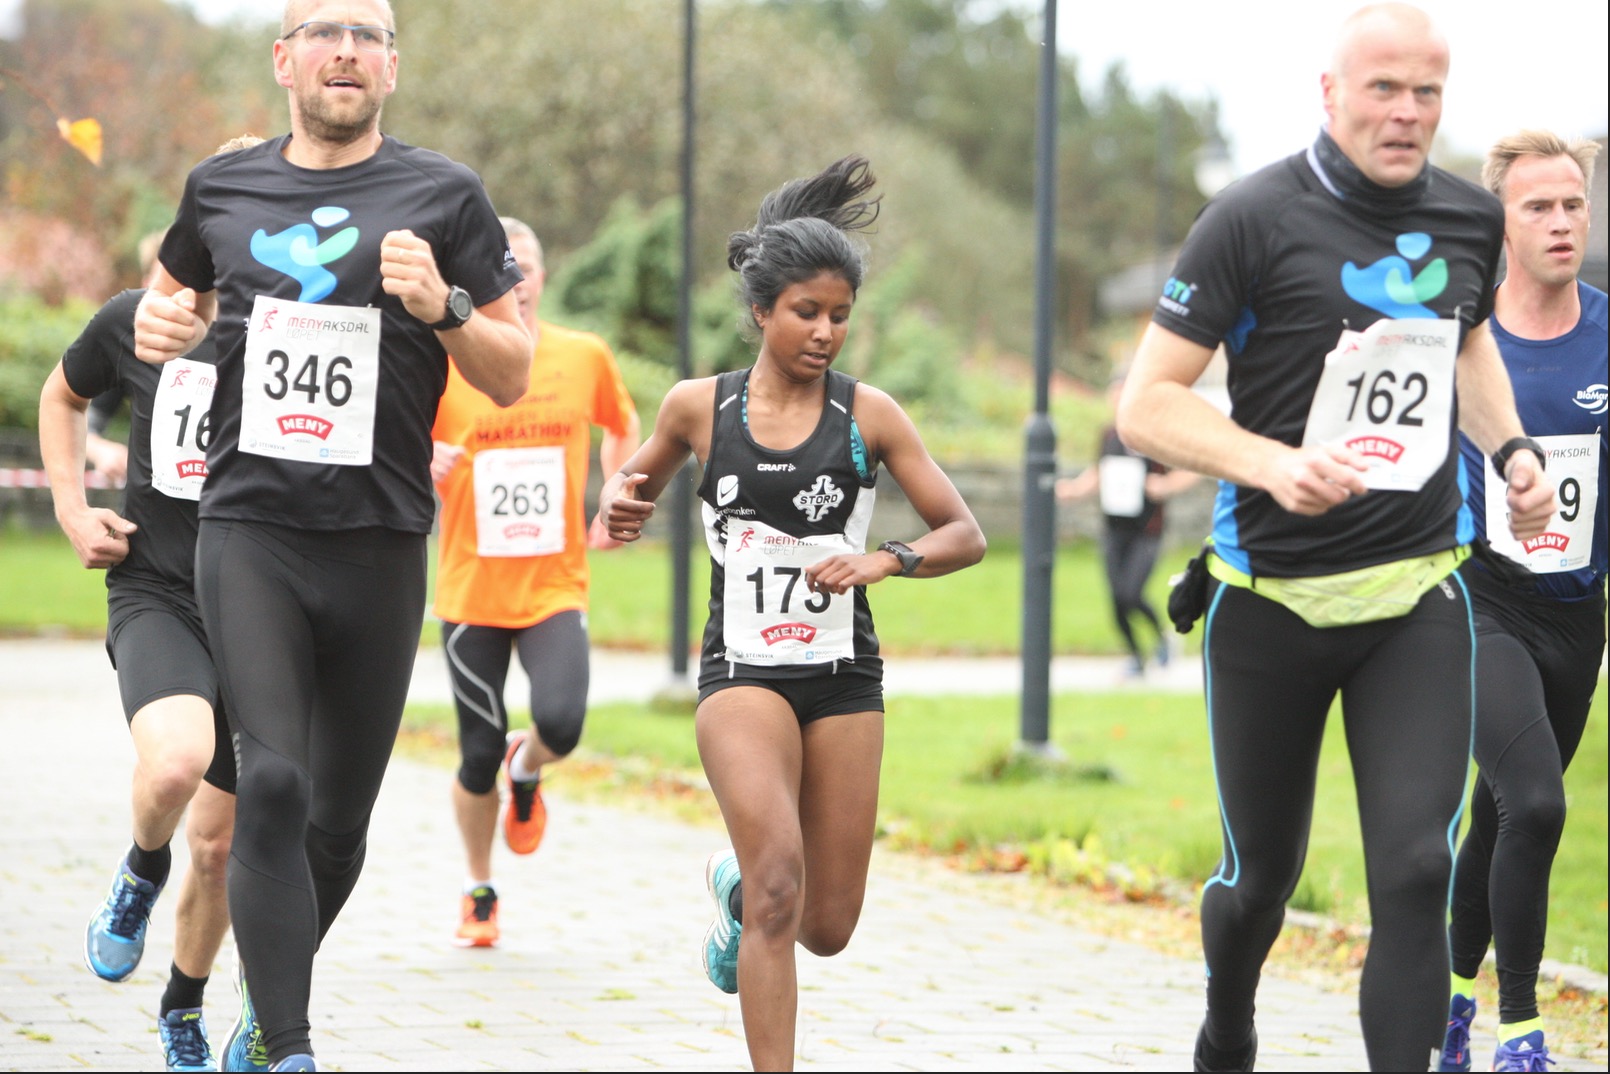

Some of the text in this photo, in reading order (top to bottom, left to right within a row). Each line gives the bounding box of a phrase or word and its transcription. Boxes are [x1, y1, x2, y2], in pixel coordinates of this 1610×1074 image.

[263, 349, 353, 407] 346
[1346, 369, 1428, 427] 162
[281, 418, 328, 434] MENY
[1350, 439, 1400, 457] MENY
[757, 463, 788, 472] CRAFT
[492, 483, 549, 516] 263
[800, 494, 838, 505] STORD
[1527, 535, 1565, 549] MENY
[746, 567, 831, 614] 173
[767, 626, 812, 641] MENY
